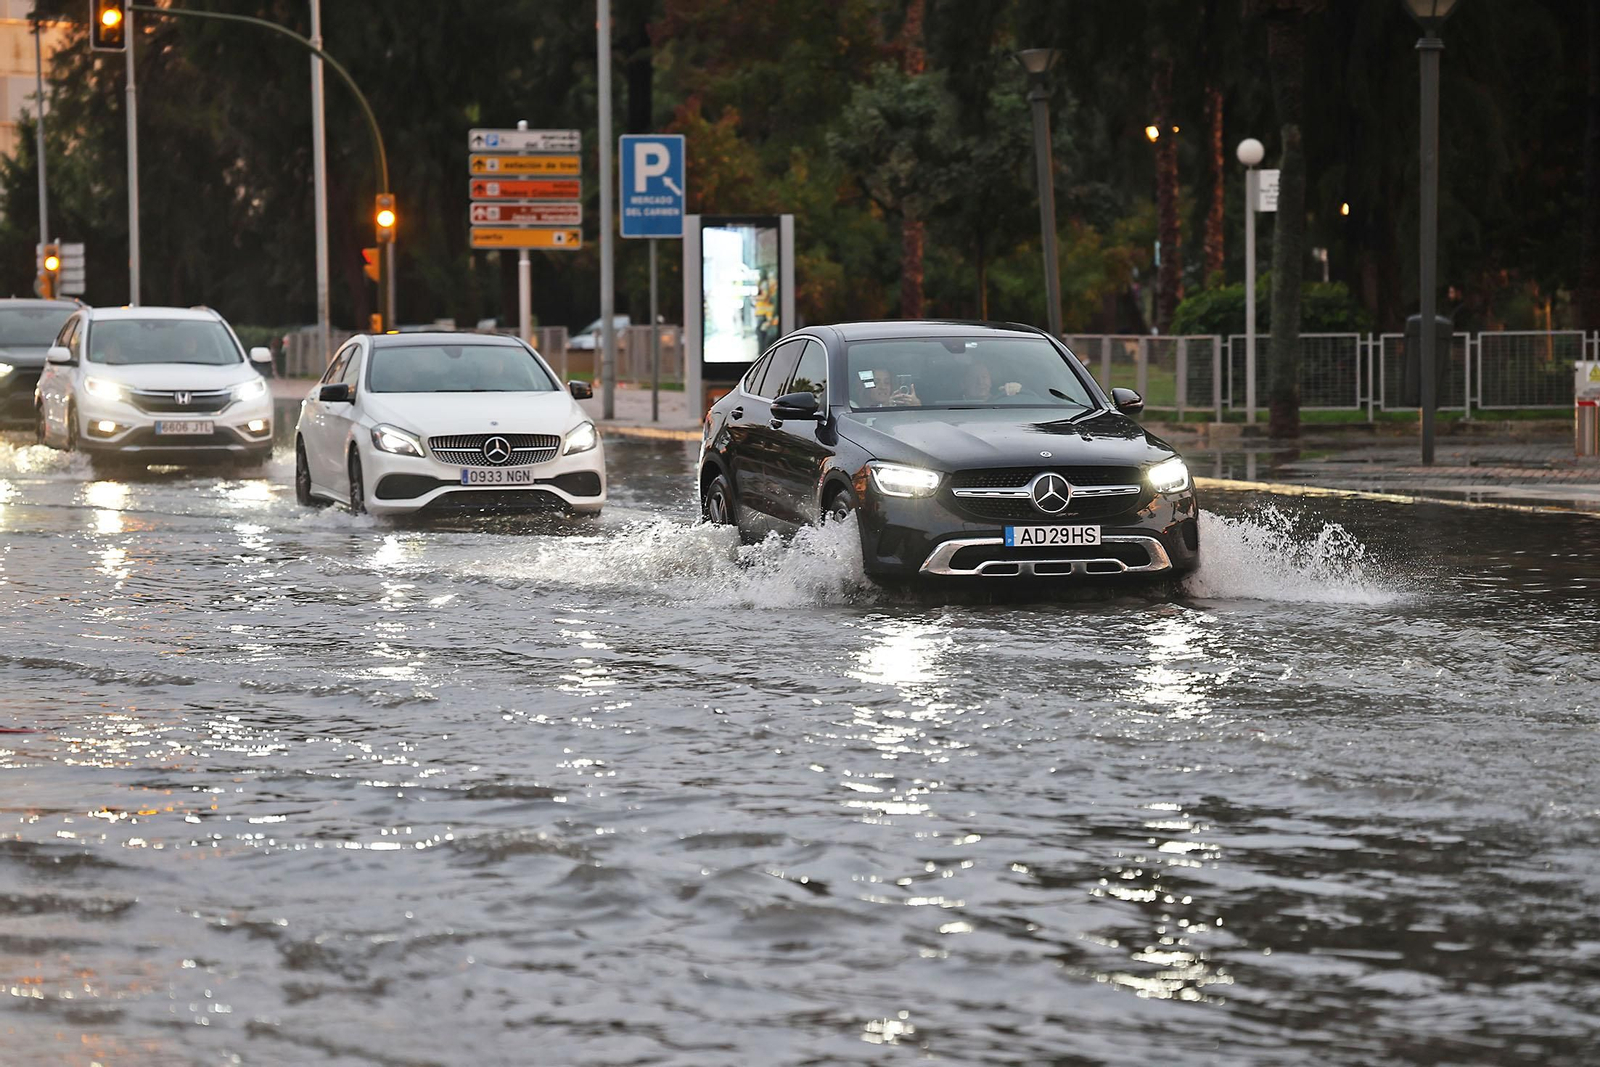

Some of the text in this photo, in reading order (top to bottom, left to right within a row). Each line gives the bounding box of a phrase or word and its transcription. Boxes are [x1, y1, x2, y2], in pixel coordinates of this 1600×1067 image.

[634, 142, 671, 193] P
[630, 195, 674, 205] MERCADO
[625, 207, 680, 217] DEL CARMEN
[470, 469, 530, 482] 0933 NGN
